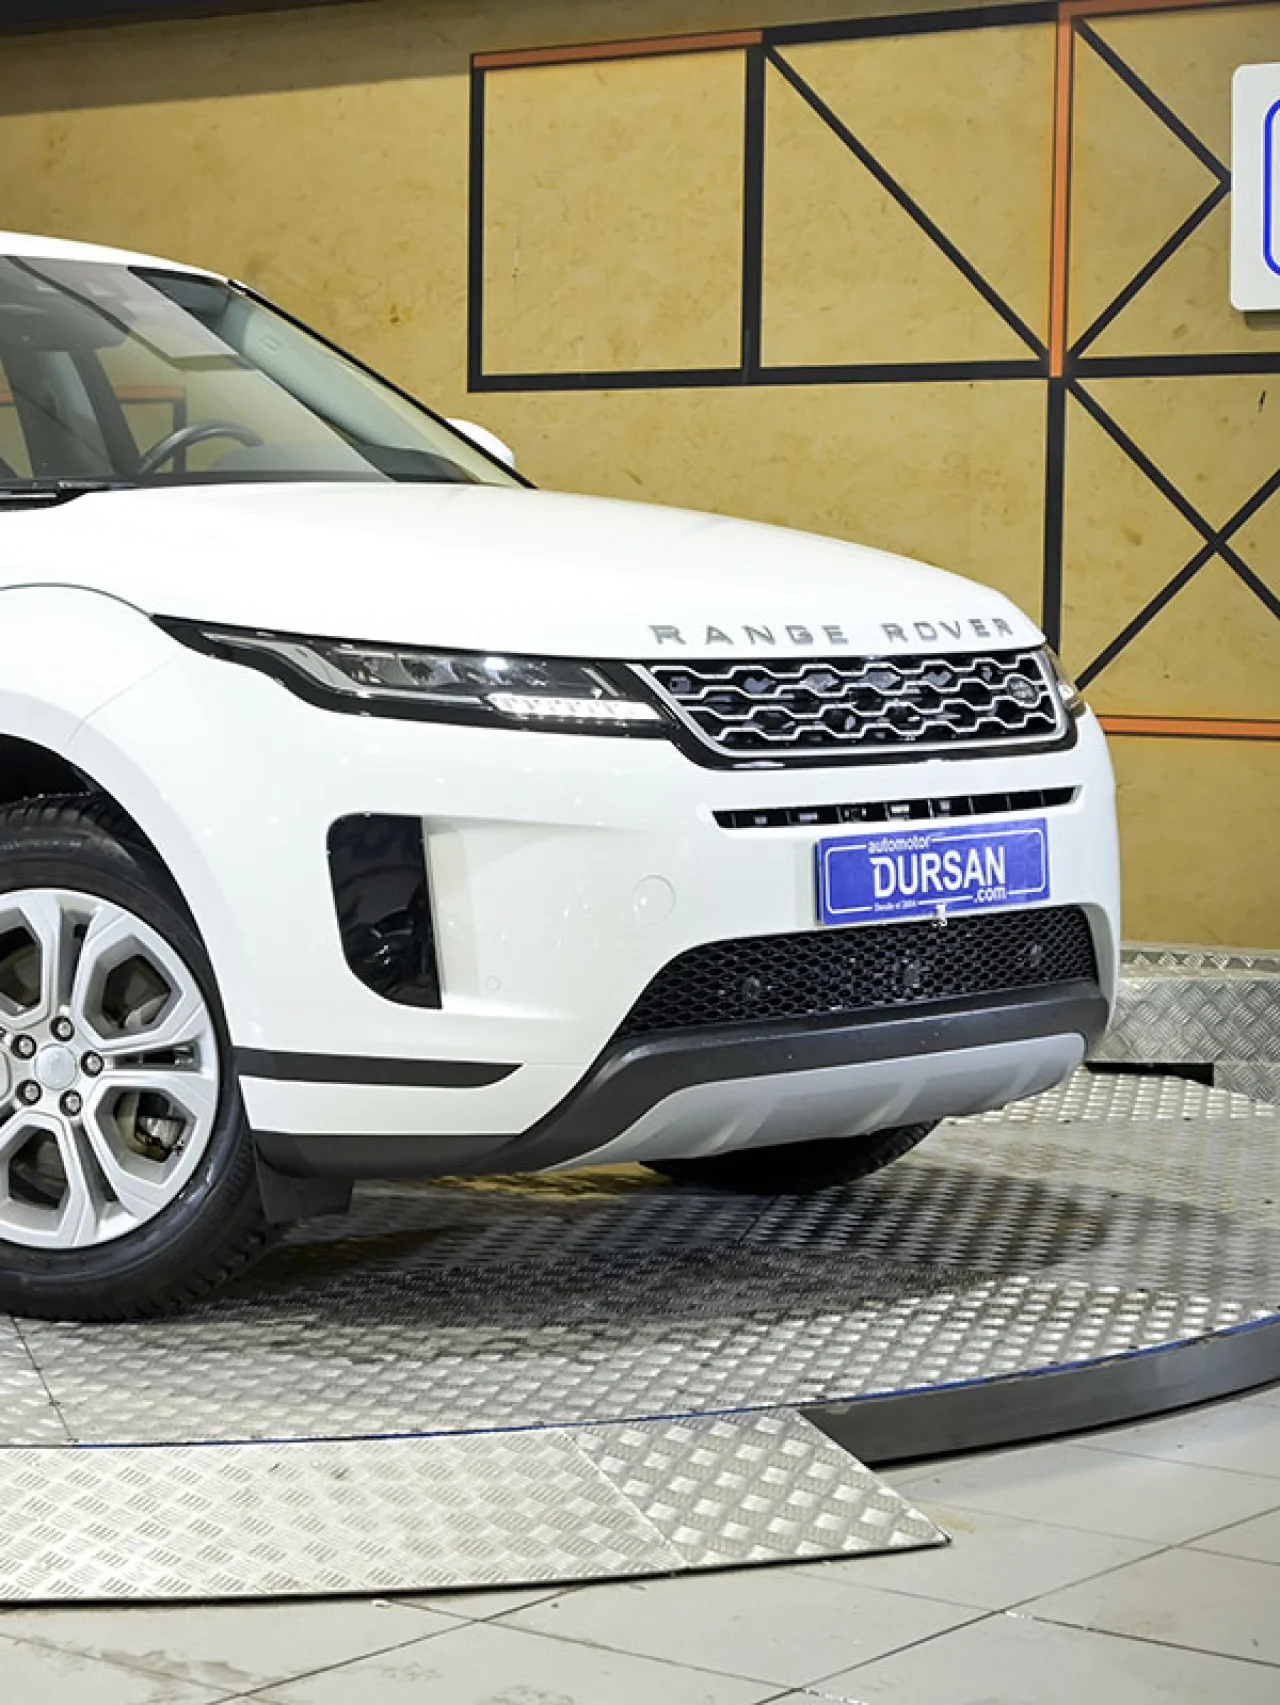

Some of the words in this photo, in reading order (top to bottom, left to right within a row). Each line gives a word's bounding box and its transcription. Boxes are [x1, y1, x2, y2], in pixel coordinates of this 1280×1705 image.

[649, 624, 848, 646] RANGE
[880, 617, 1014, 643] ROVER
[867, 835, 931, 854] automotor
[870, 845, 1006, 898] DURSAN
[972, 886, 1007, 903] .com
